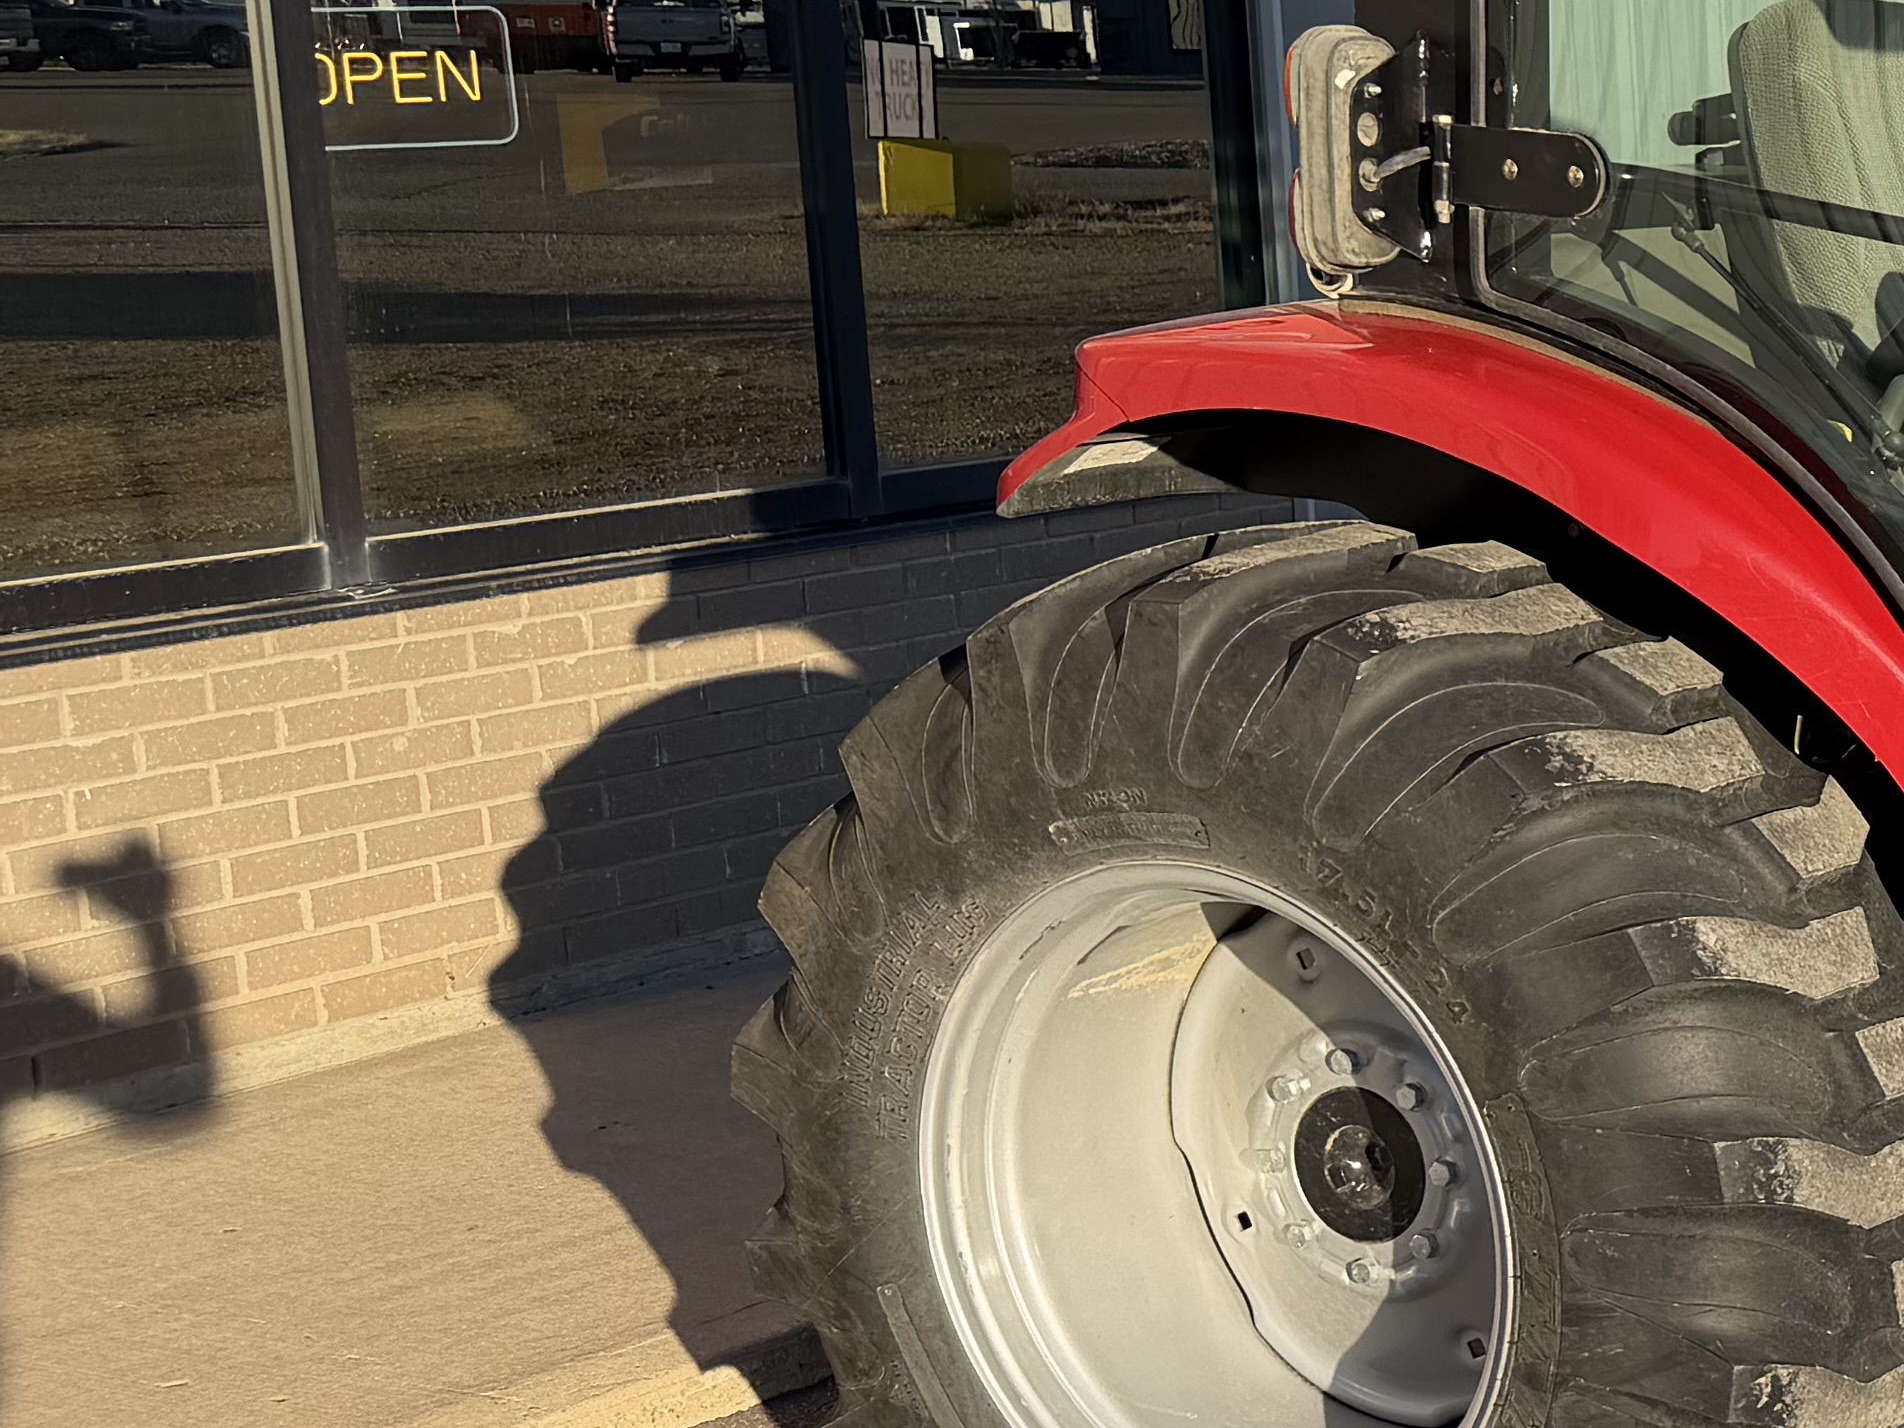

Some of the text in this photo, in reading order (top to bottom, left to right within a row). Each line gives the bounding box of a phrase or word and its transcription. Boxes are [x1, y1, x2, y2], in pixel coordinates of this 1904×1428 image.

[844, 892, 942, 1108] INDUSTRIAL
[876, 896, 990, 1141] TRACTOR LUG
